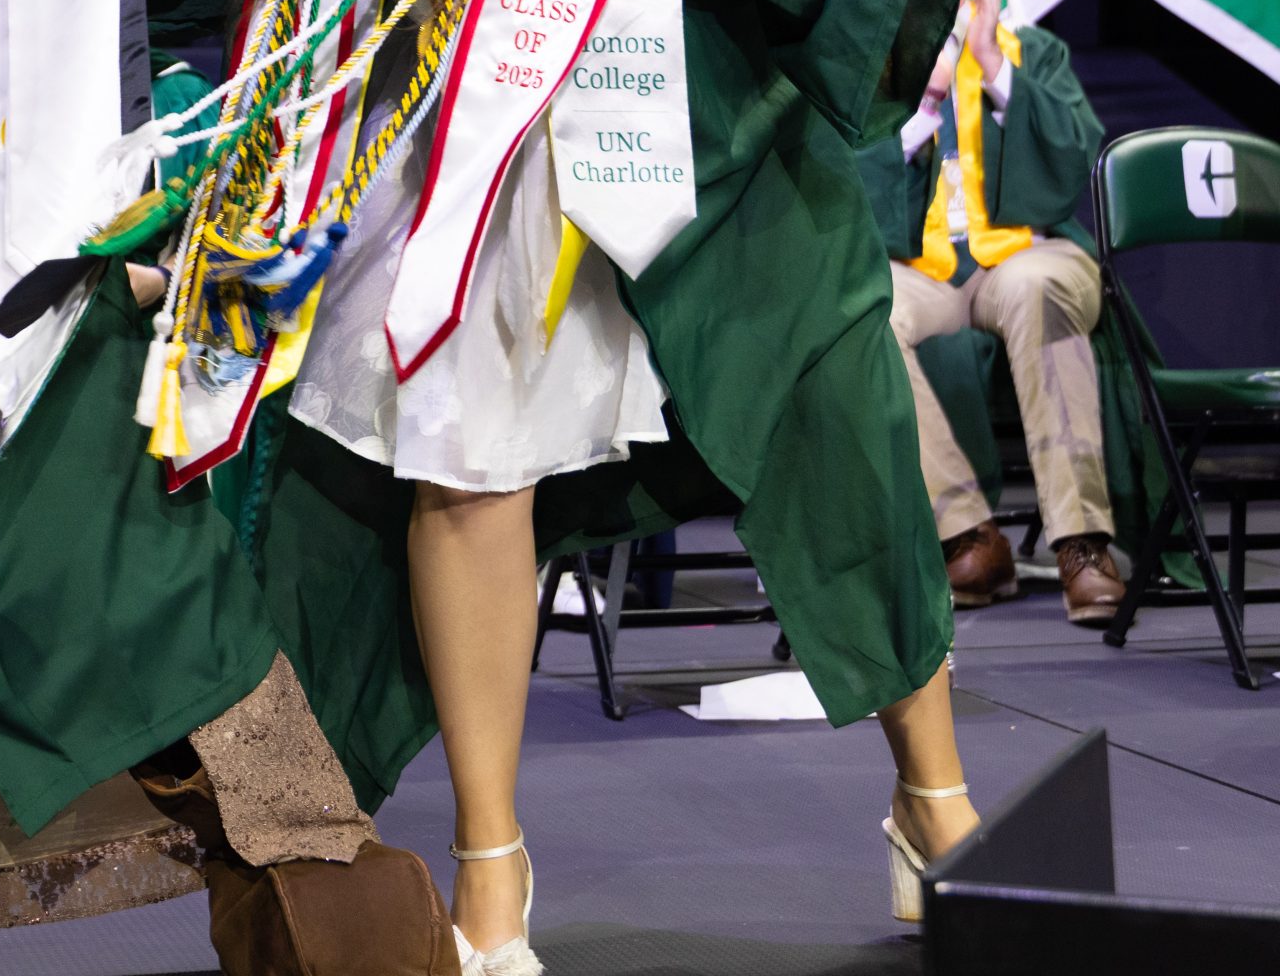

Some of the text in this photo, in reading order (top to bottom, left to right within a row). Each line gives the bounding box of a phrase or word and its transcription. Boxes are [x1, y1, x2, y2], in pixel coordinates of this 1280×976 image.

[514, 29, 547, 53] OF
[495, 62, 545, 89] 2025
[573, 67, 666, 97] College
[596, 132, 652, 153] UNC
[573, 161, 685, 184] Charlotte
